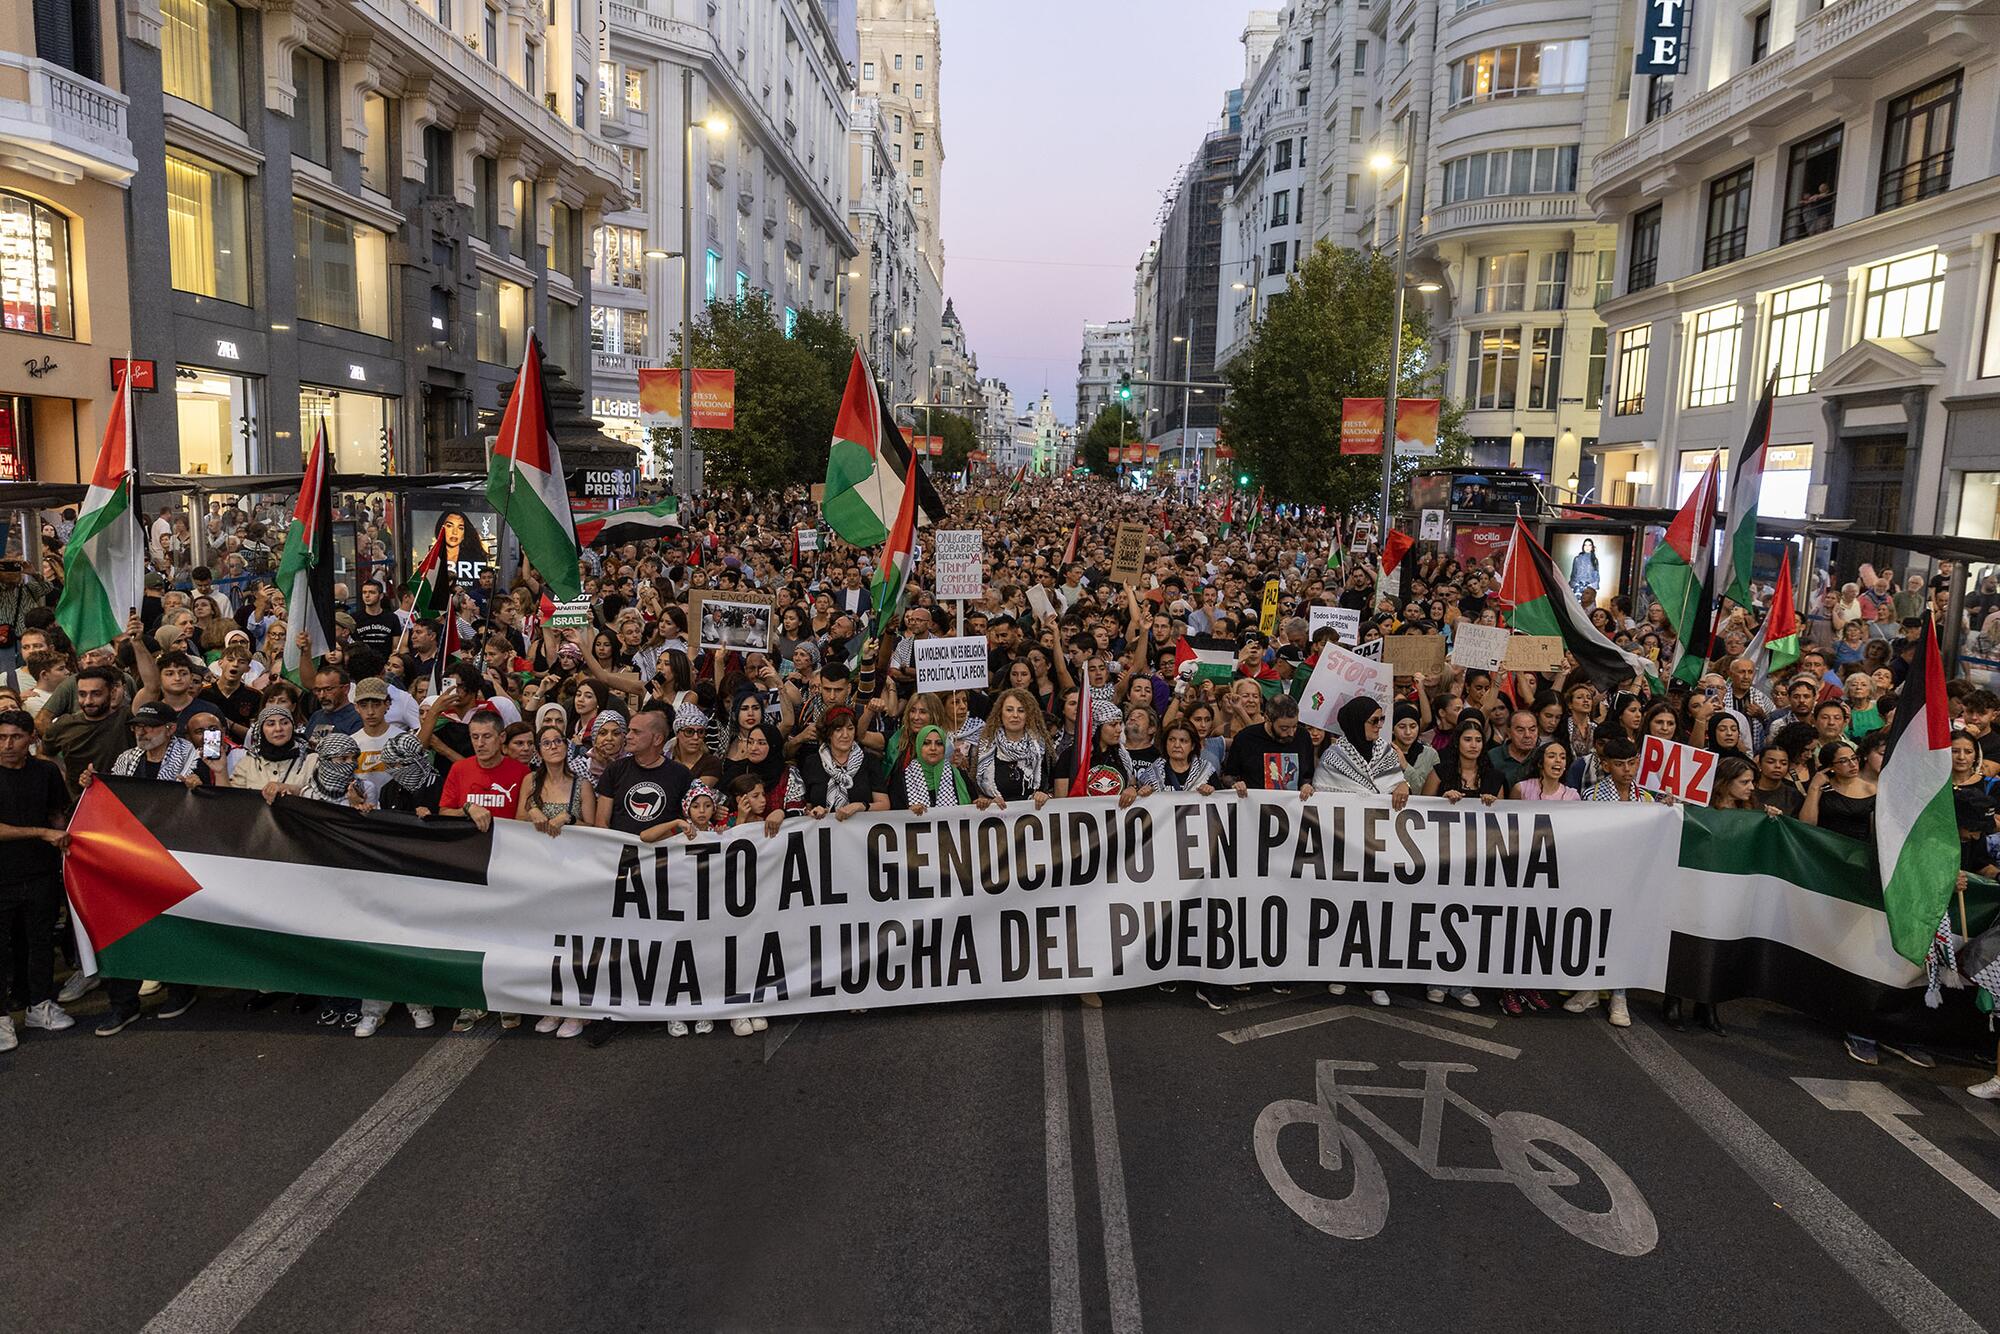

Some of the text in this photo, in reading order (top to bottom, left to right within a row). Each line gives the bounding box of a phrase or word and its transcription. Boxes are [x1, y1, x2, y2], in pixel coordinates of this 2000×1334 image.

[586, 471, 631, 483] KIOSCO
[585, 484, 631, 495] PRENSA
[1474, 532, 1500, 541] nocilla
[938, 544, 982, 553] COBARDES
[970, 553, 981, 564] YA
[942, 562, 970, 573] TRUMP
[1265, 589, 1277, 605] PAZ
[1339, 614, 1358, 622] pueblos
[918, 648, 925, 661] LA
[925, 646, 950, 660] VIOLENCIA
[951, 646, 957, 659] NO
[958, 645, 963, 658] ES
[1354, 641, 1380, 657] PAZ
[919, 669, 926, 682] ES
[956, 666, 961, 679] Y
[961, 666, 969, 679] LA
[1327, 650, 1378, 685] STOP
[1639, 737, 1714, 803] PAZ
[467, 794, 505, 807] PUMA
[612, 803, 1559, 921] ALTO AL GENOCIDIO EN PALESTINA
[550, 895, 1612, 1006] ¡VIVA LA LUCHA DEL PUEBLO PALESTINO!
